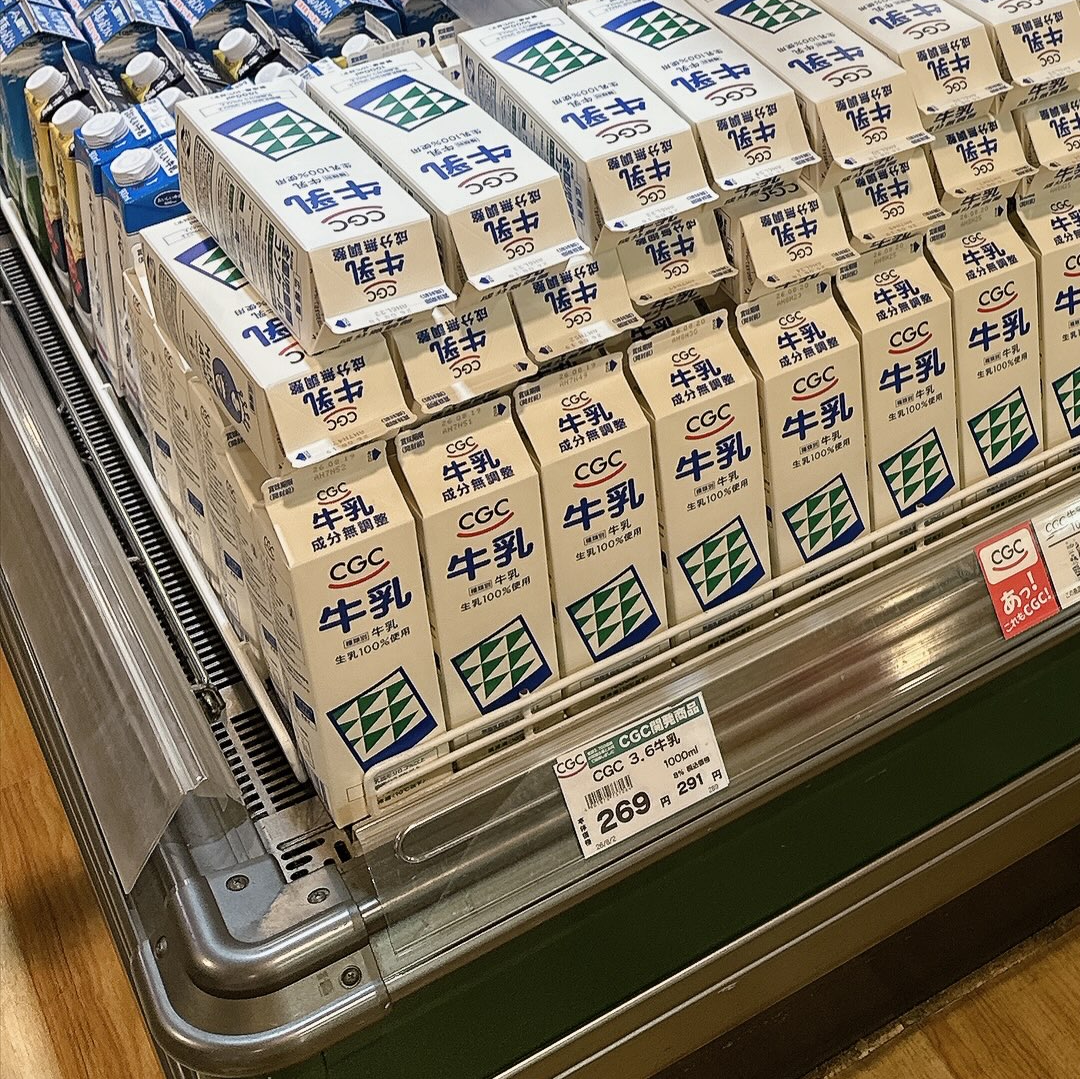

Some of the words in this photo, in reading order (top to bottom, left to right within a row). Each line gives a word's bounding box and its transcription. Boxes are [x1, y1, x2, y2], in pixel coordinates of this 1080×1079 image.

[283, 179, 382, 216] 牛乳
[344, 249, 405, 286] 牛乳
[792, 365, 836, 395] CGC
[879, 347, 946, 394] 牛乳
[781, 392, 854, 441] 牛乳
[311, 512, 389, 553] 成分無調整
[458, 498, 511, 532] CGC
[329, 546, 385, 582] CGC
[446, 526, 534, 581] 牛乳
[991, 538, 1025, 565] CGC
[319, 575, 413, 636] 牛乳
[334, 626, 411, 665] 生乳100%使用
[556, 754, 586, 774] CGC
[592, 760, 625, 782] CGC
[663, 745, 699, 768] 1000ml
[676, 772, 704, 796] 291
[712, 769, 723, 782] 円
[596, 791, 651, 835] 269
[660, 795, 672, 808] 円
